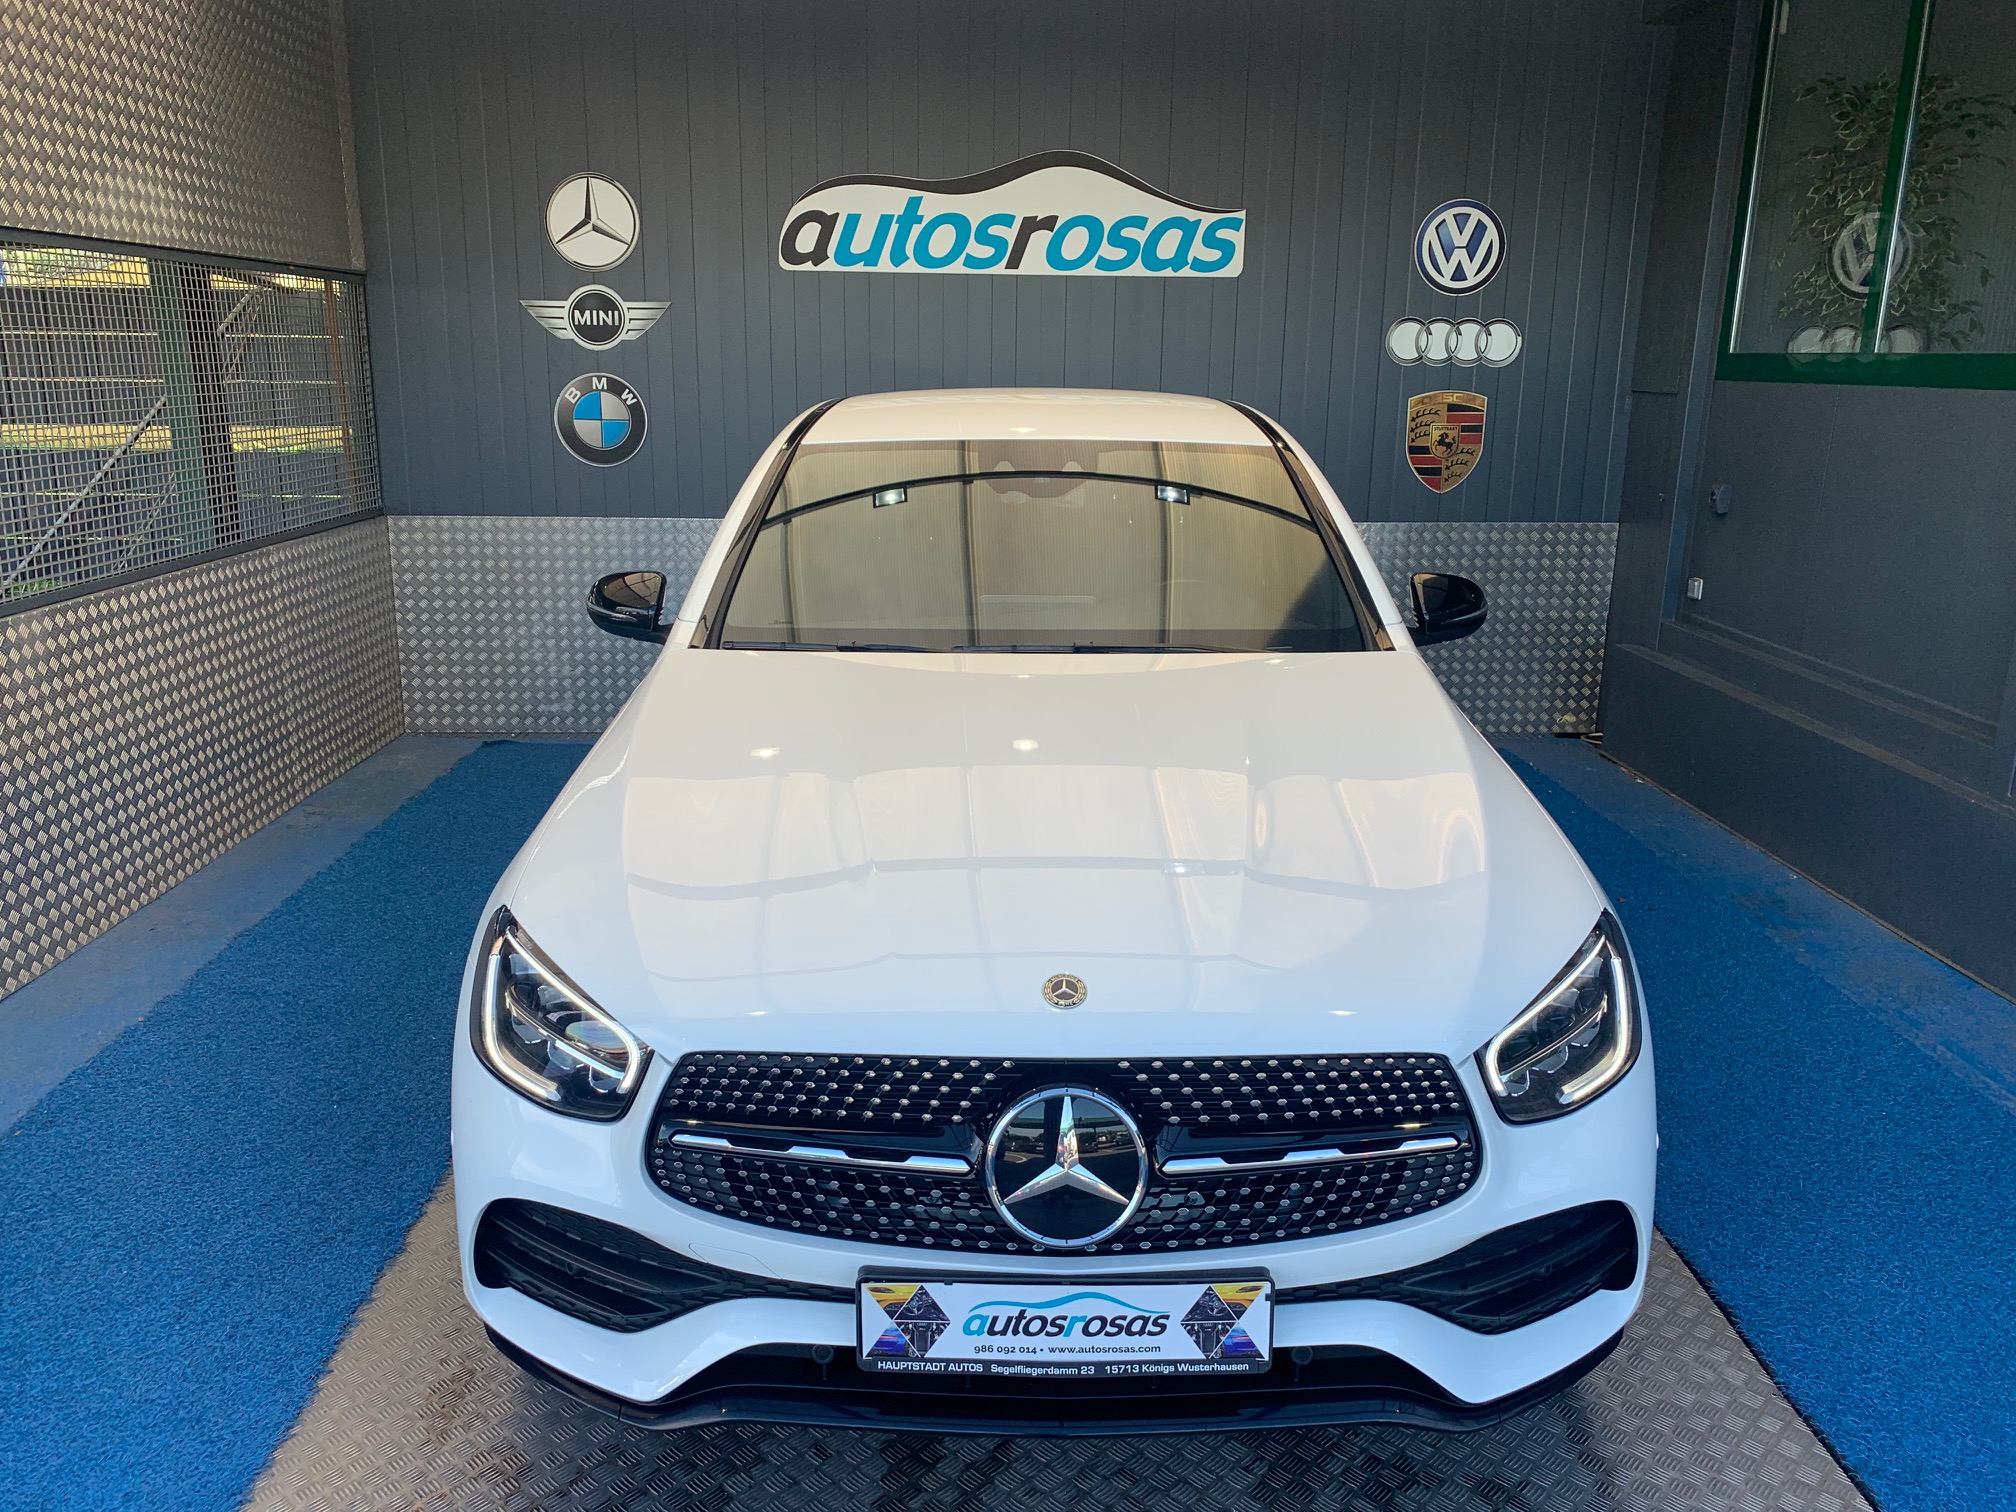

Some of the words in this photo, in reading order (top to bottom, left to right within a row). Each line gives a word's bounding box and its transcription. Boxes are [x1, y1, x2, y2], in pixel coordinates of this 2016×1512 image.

[780, 196, 1244, 273] autosrosas
[573, 309, 620, 326] MINI
[564, 376, 637, 406] BMW
[962, 1308, 1171, 1338] autosrosas
[973, 1344, 994, 1354] 986
[997, 1345, 1016, 1355] 092
[1048, 1344, 1161, 1354] www.autosrosas.com
[877, 1360, 947, 1371] HAUPTSTADT
[948, 1362, 983, 1372] AUTOS
[990, 1364, 1078, 1376] Segelfliegerdamm
[1080, 1366, 1095, 1375] 23
[1104, 1365, 1140, 1374] 15713
[1141, 1363, 1175, 1375] Königs
[1177, 1362, 1250, 1373] Wusterhausen
